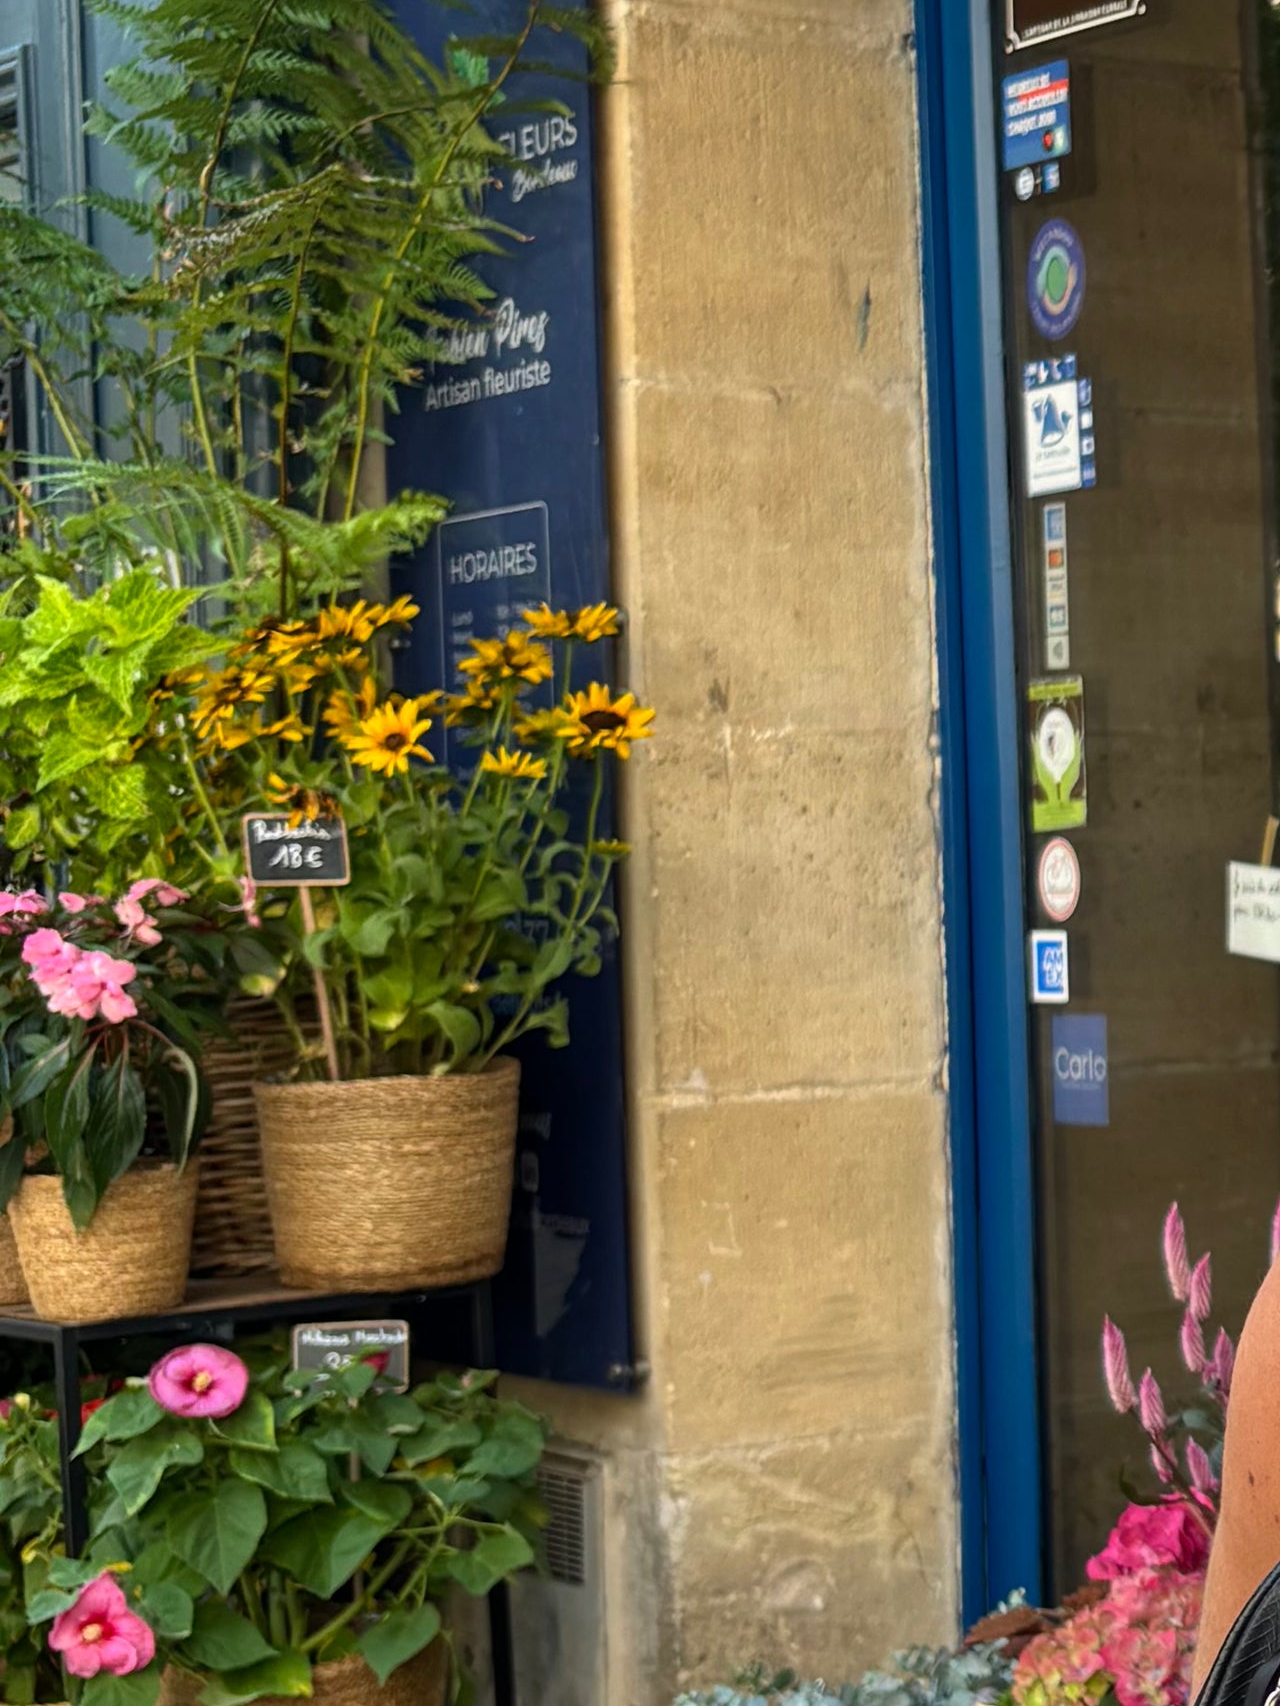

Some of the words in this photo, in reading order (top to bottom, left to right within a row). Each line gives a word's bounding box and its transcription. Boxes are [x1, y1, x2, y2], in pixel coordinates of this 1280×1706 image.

[424, 369, 482, 412] Artisan
[483, 357, 551, 400] fleuriste
[450, 542, 538, 585] HORAIRES
[1055, 1046, 1107, 1083] Carlo
